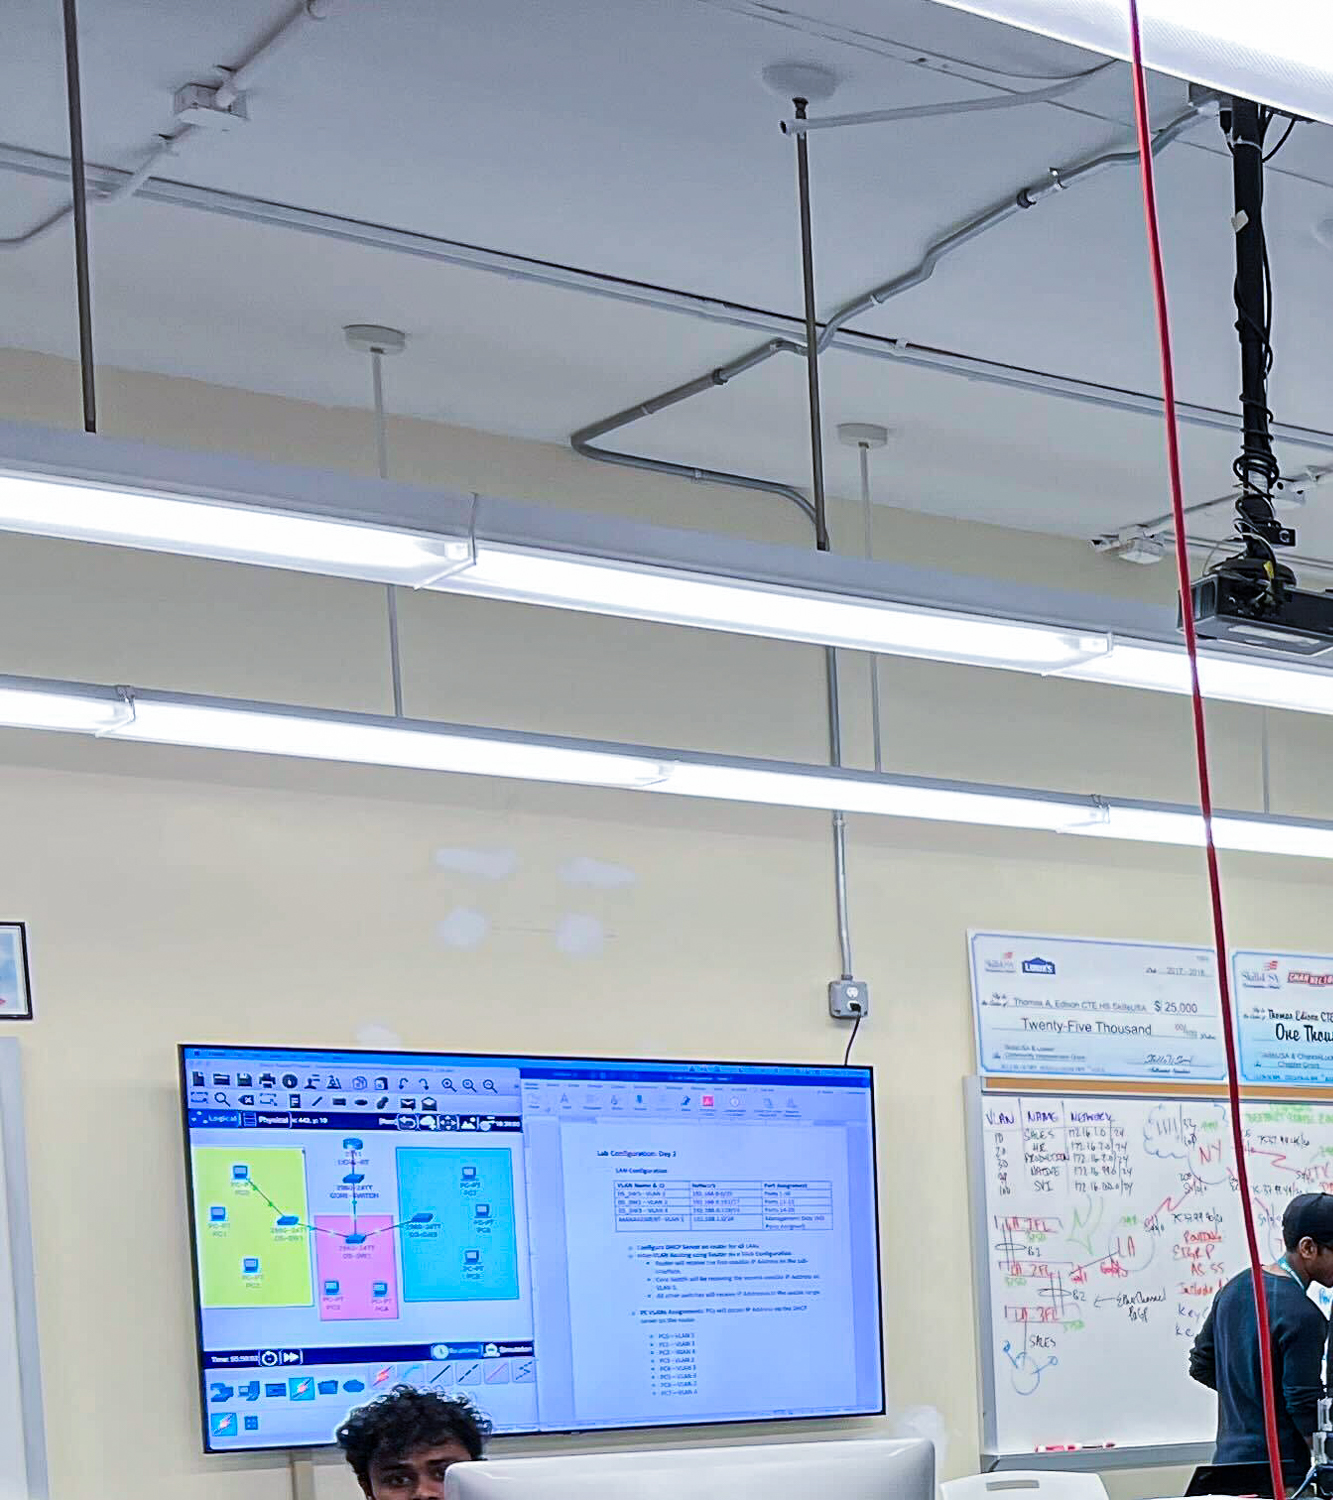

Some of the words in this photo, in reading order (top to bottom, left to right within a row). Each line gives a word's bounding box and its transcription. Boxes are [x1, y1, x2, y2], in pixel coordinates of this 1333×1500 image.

[1154, 1000, 1161, 1012] $
[1021, 1018, 1092, 1034] Twenty-Five
[1095, 1021, 1152, 1036] Thousand
[1275, 1023, 1301, 1041] One
[209, 1114, 238, 1123] Logical
[985, 1110, 1014, 1125] VLAN
[1028, 1111, 1058, 1123] NAME
[1199, 1139, 1221, 1165] NY
[1117, 1235, 1137, 1258] LA
